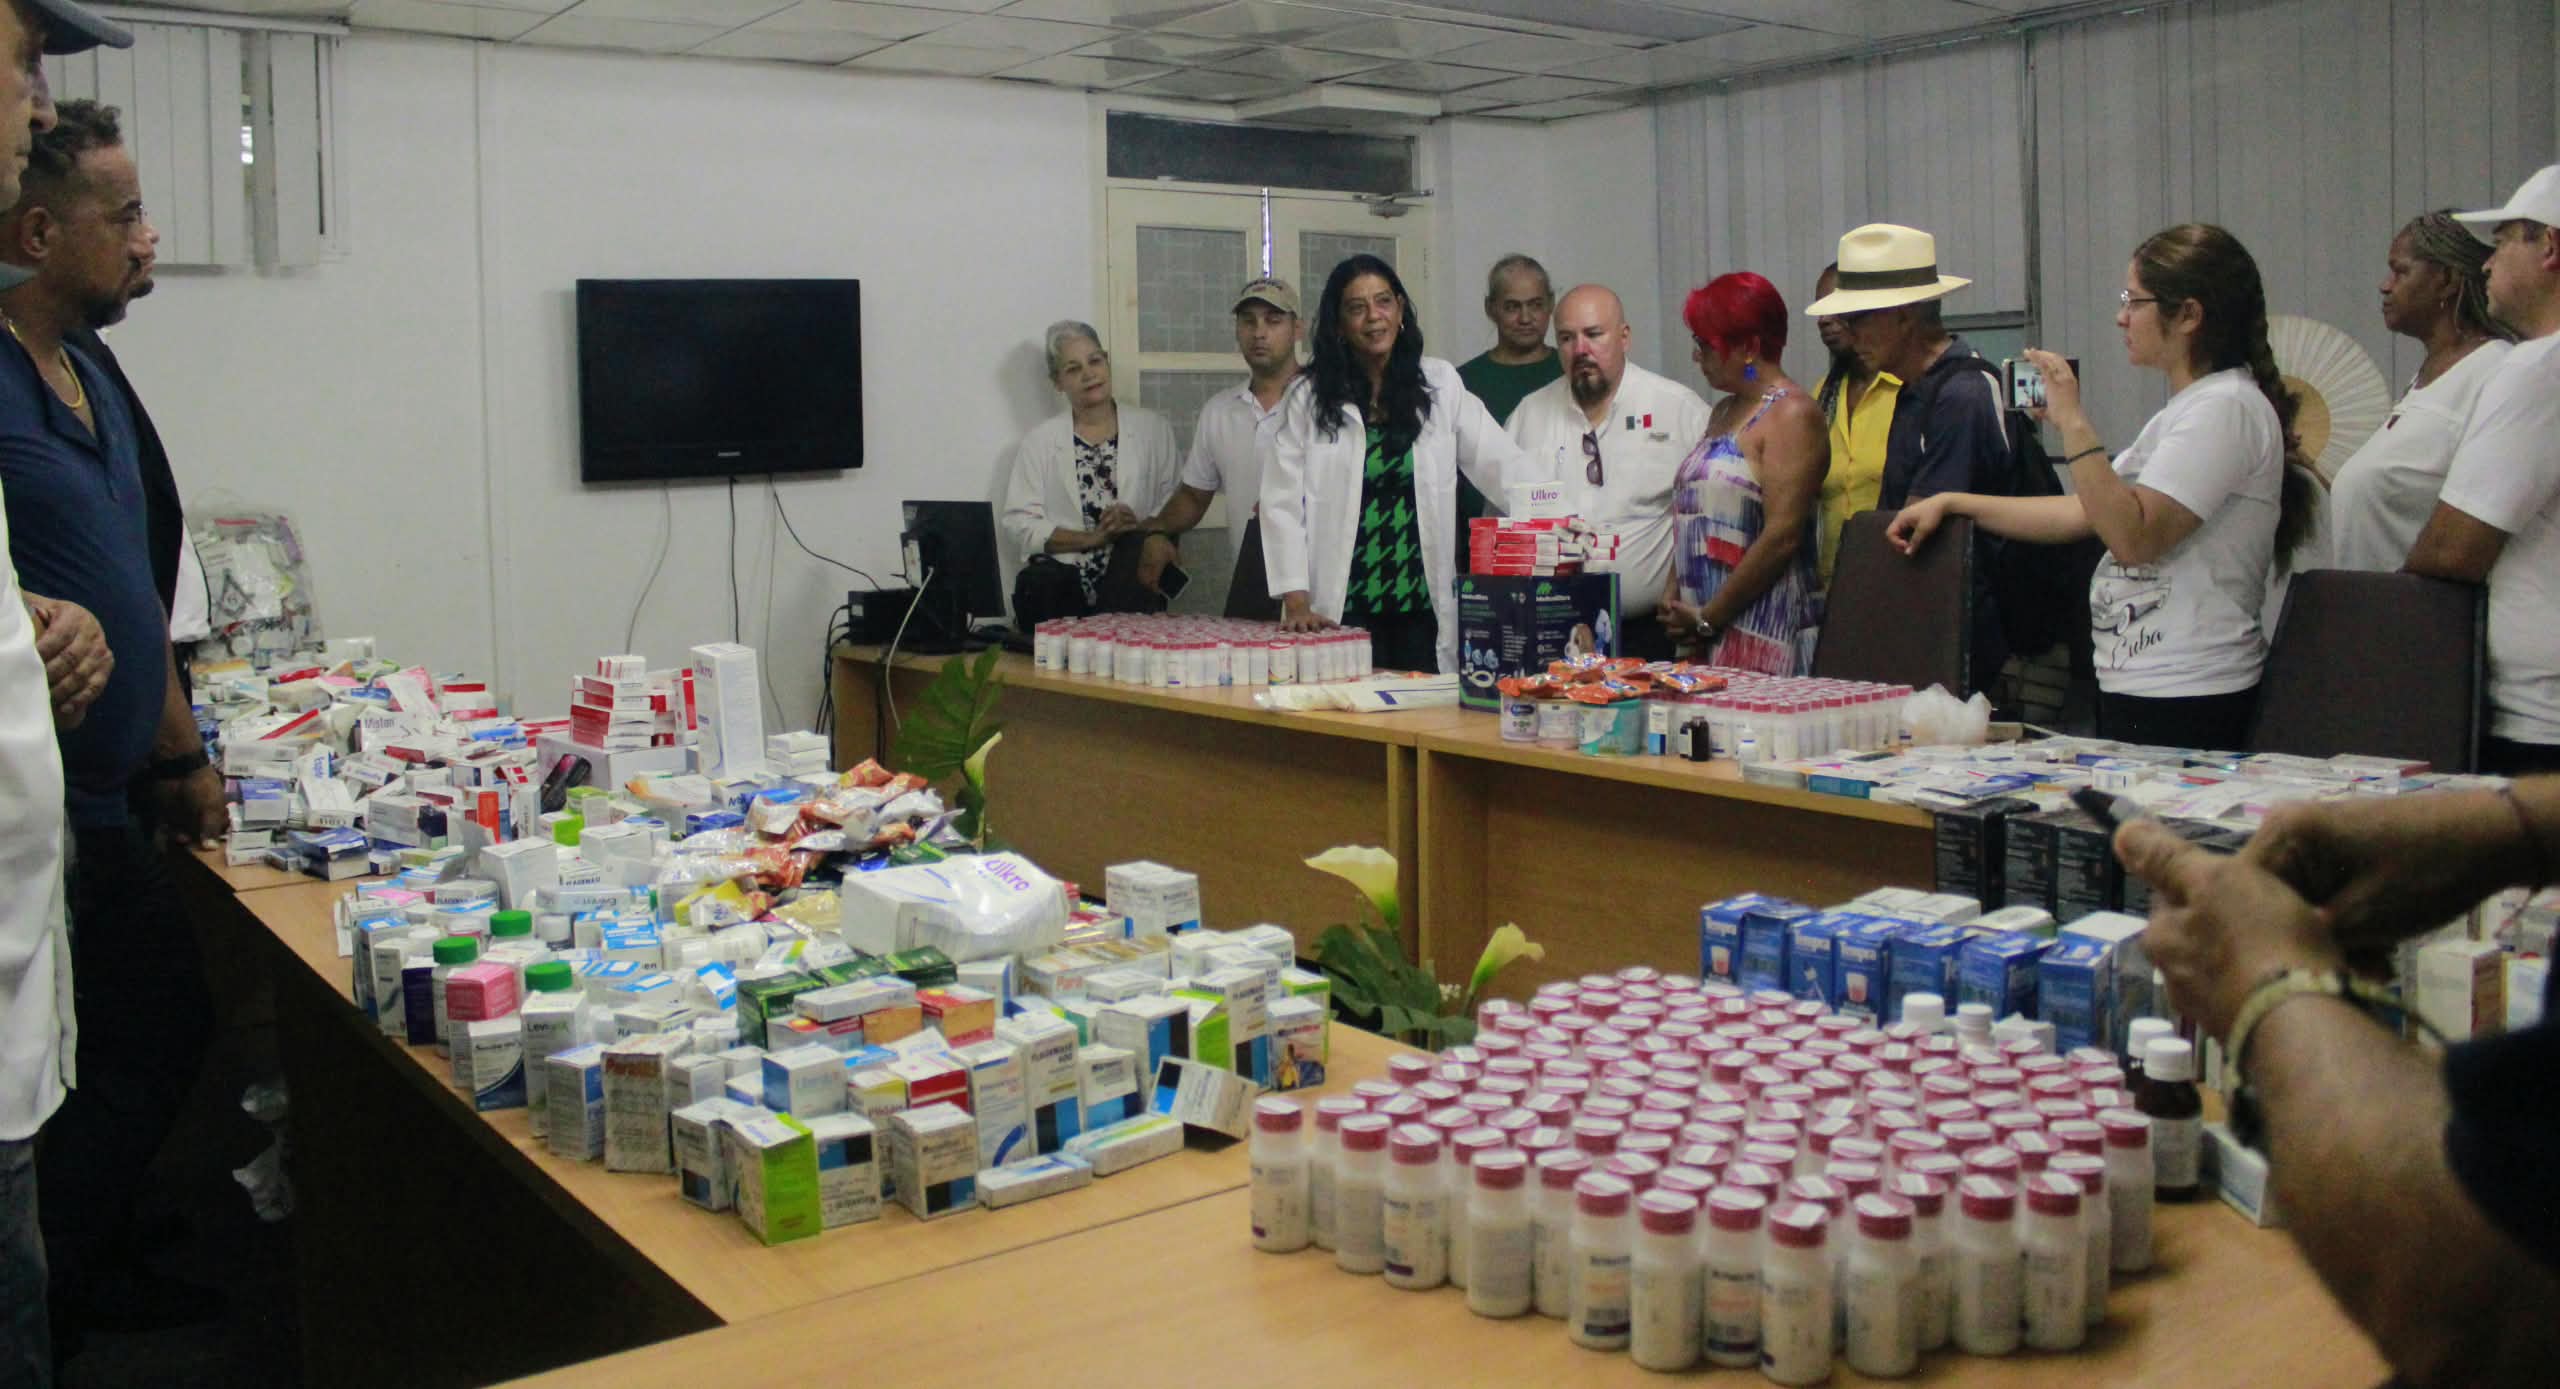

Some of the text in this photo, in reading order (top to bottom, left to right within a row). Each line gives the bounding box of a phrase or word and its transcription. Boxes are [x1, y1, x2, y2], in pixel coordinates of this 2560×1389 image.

[1530, 487, 1559, 501] Ulkro
[2112, 626, 2164, 671] Cuba
[985, 859, 1030, 892] Ulkro
